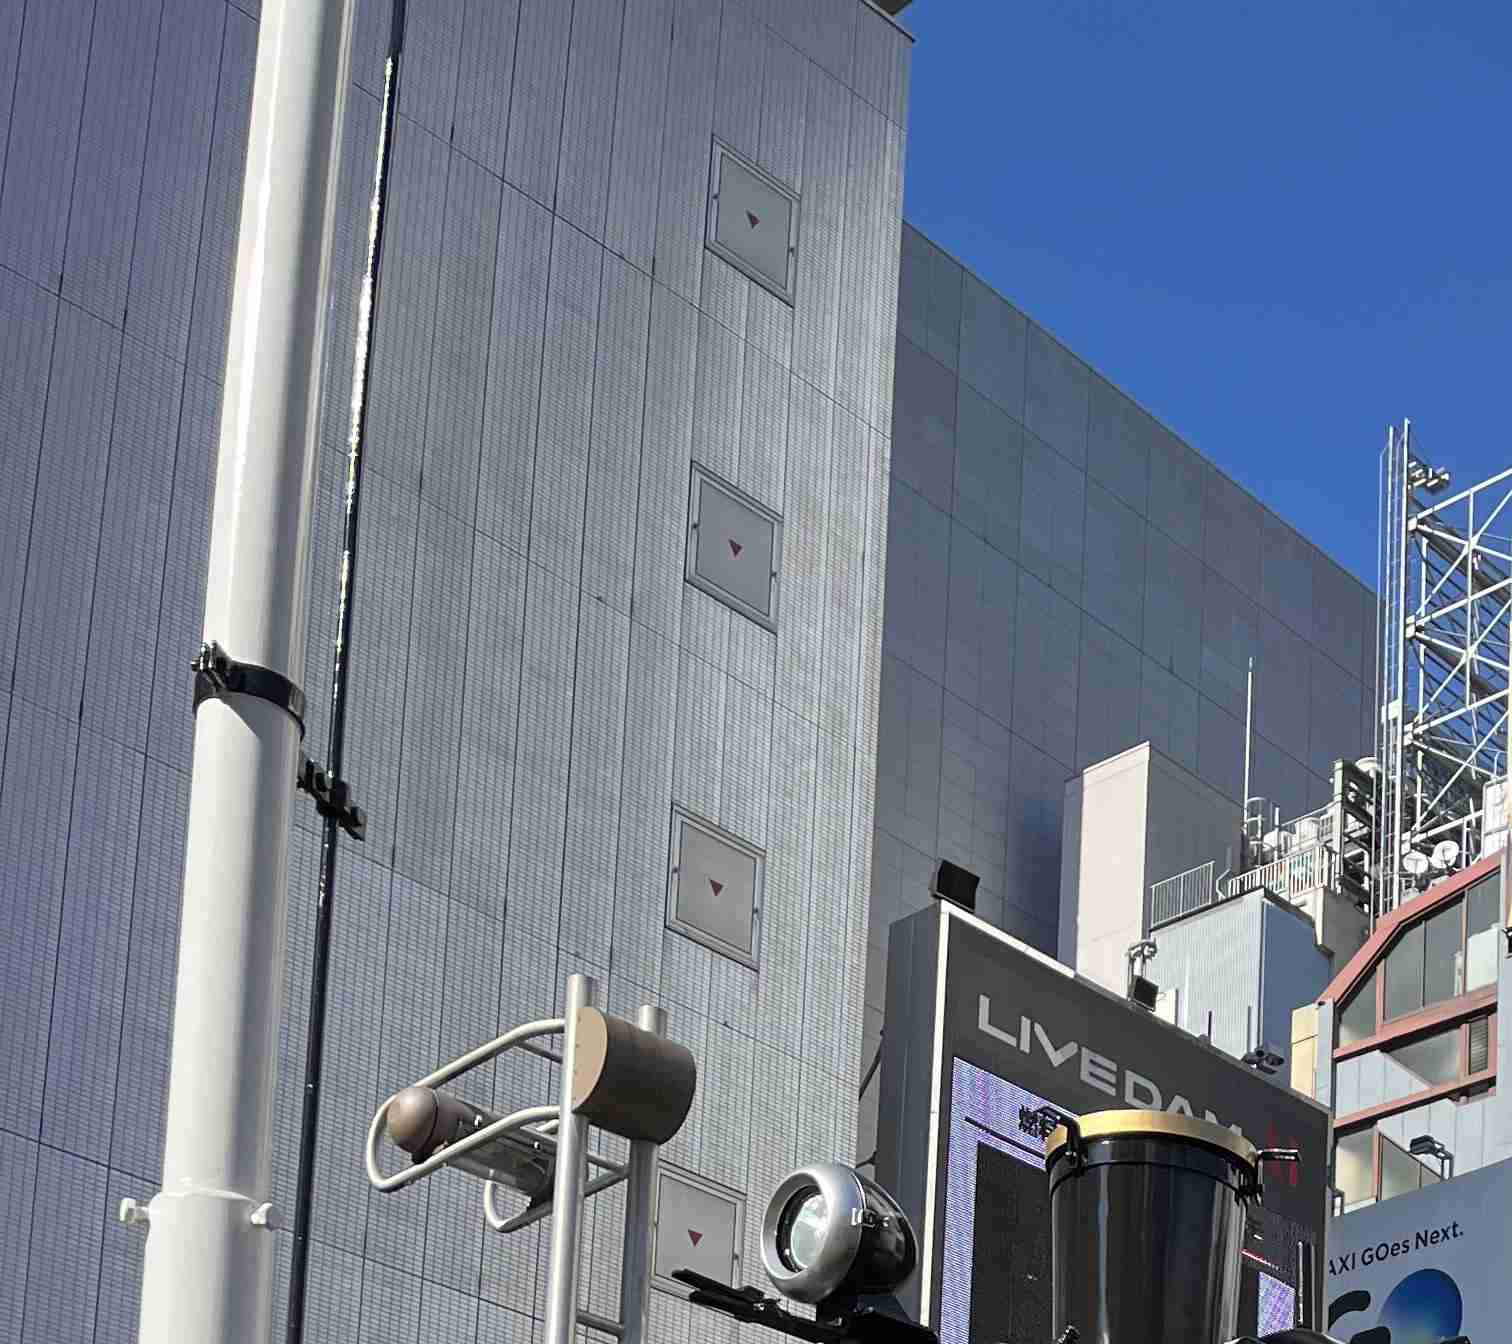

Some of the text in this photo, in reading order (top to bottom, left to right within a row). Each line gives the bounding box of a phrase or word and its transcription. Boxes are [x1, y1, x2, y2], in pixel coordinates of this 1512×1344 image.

[1329, 1221, 1464, 1276] AXI GOes Next.
